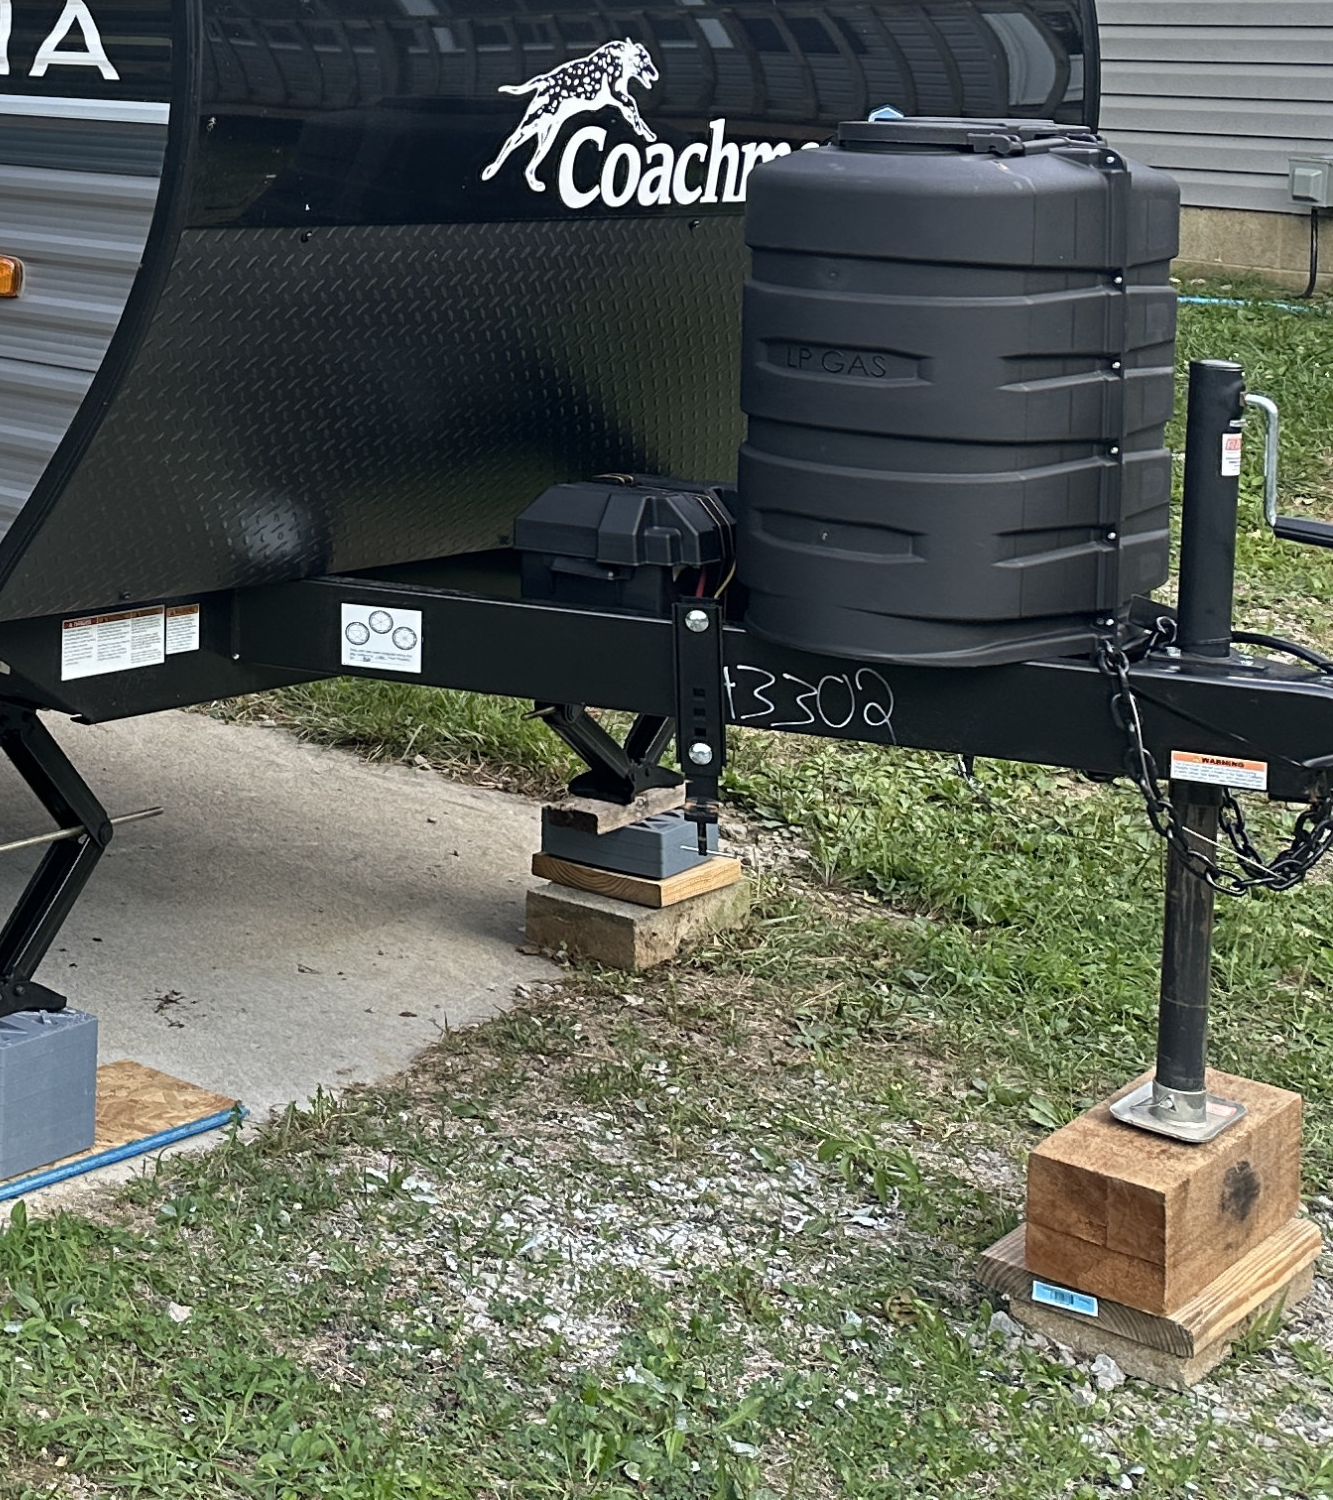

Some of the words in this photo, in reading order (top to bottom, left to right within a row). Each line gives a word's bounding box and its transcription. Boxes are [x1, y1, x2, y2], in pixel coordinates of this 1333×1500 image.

[558, 118, 821, 209] Coach
[787, 347, 812, 369] LP
[821, 350, 887, 378] GAS
[1201, 756, 1245, 769] WARNING
